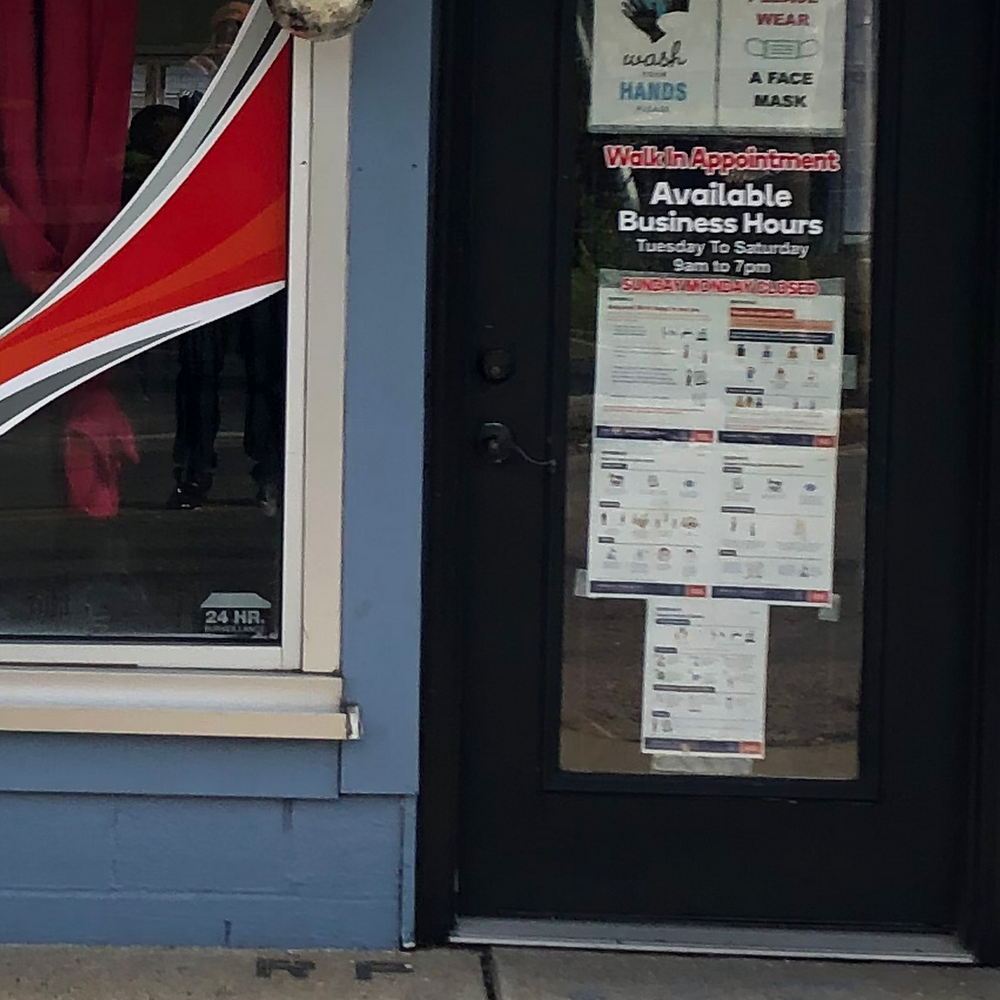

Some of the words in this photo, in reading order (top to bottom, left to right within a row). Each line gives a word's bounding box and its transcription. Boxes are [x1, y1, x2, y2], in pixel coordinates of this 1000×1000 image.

[756, 13, 810, 27] WEAR
[622, 40, 689, 67] wash
[748, 71, 763, 85] A
[767, 71, 815, 86] FACE
[619, 81, 688, 101] HANDS
[753, 94, 809, 108] MASK
[603, 145, 664, 169] Walk
[690, 146, 842, 175] Appointment
[649, 181, 793, 208] Available
[617, 209, 739, 233] Business
[742, 211, 824, 236] Hours
[635, 237, 706, 257] Tuesday
[708, 239, 731, 255] To
[733, 240, 810, 260] Saturday
[672, 258, 709, 273] 9am
[712, 259, 731, 275] to
[733, 259, 772, 277] 7pm
[205, 610, 229, 624] 24
